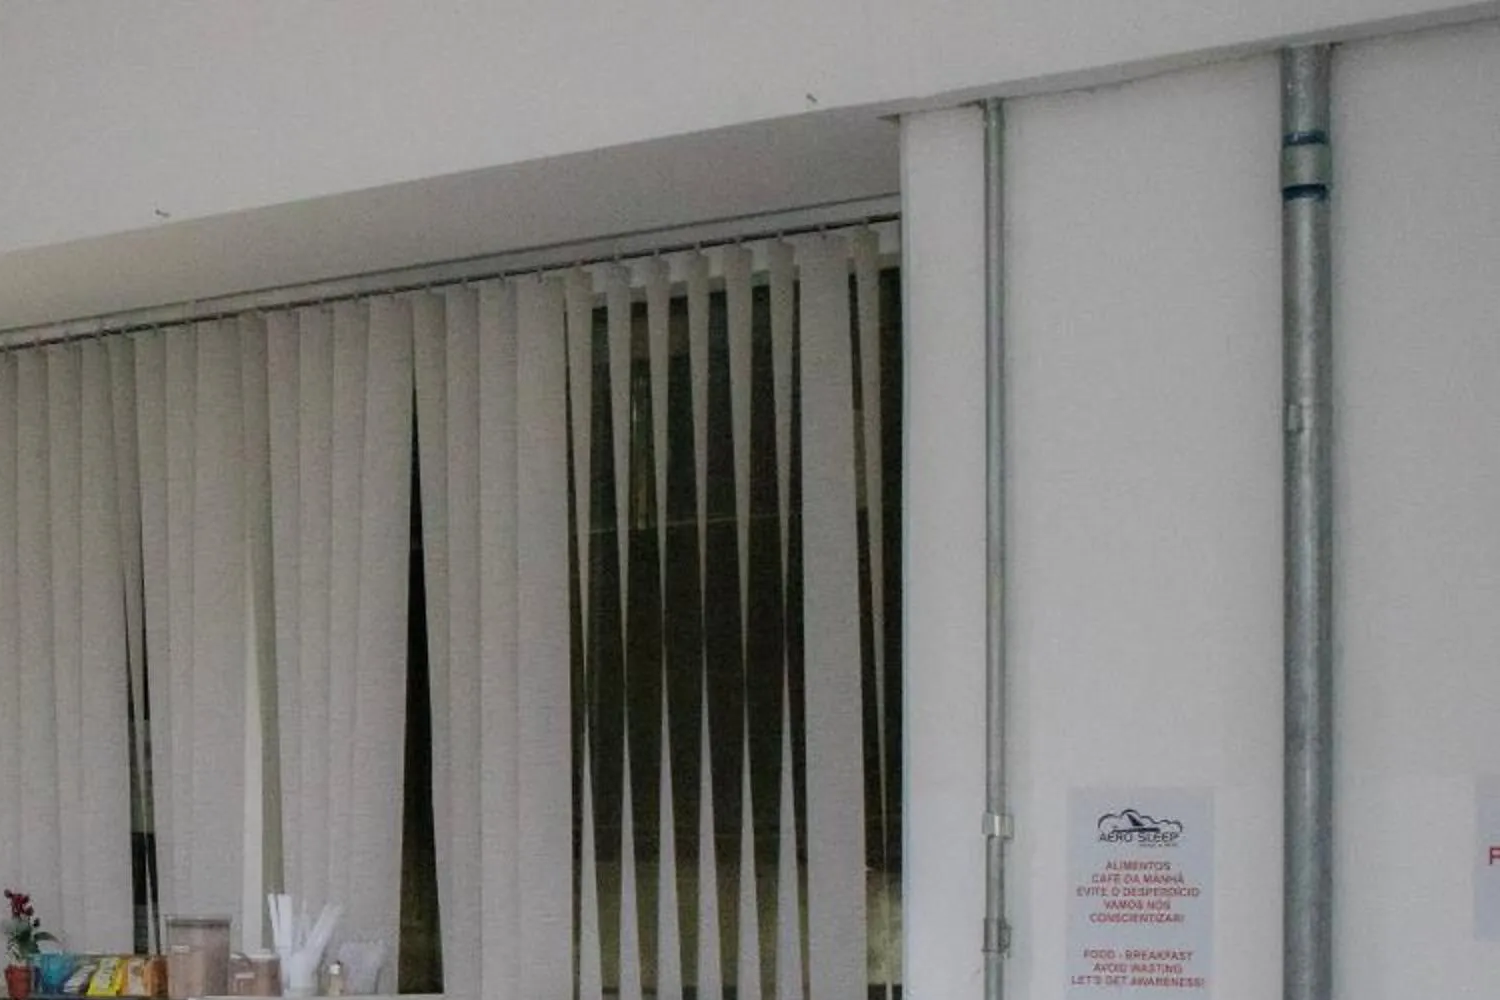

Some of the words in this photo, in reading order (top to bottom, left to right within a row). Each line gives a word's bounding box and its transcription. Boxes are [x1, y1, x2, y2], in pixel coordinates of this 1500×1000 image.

[1099, 832, 1133, 843] AERO
[1138, 832, 1180, 843] SLEEP
[1105, 861, 1171, 871] ALIMENTOS
[1123, 873, 1140, 884] DA
[1076, 887, 1108, 897] EVITE
[1111, 887, 1120, 897] O
[1103, 899, 1143, 910] VAMOS
[1083, 949, 1115, 959] FOOD
[1125, 950, 1193, 961] BREAKFAST
[1093, 963, 1127, 973] AVOID
[1131, 963, 1182, 973] WASTING
[1104, 975, 1128, 985] GET
